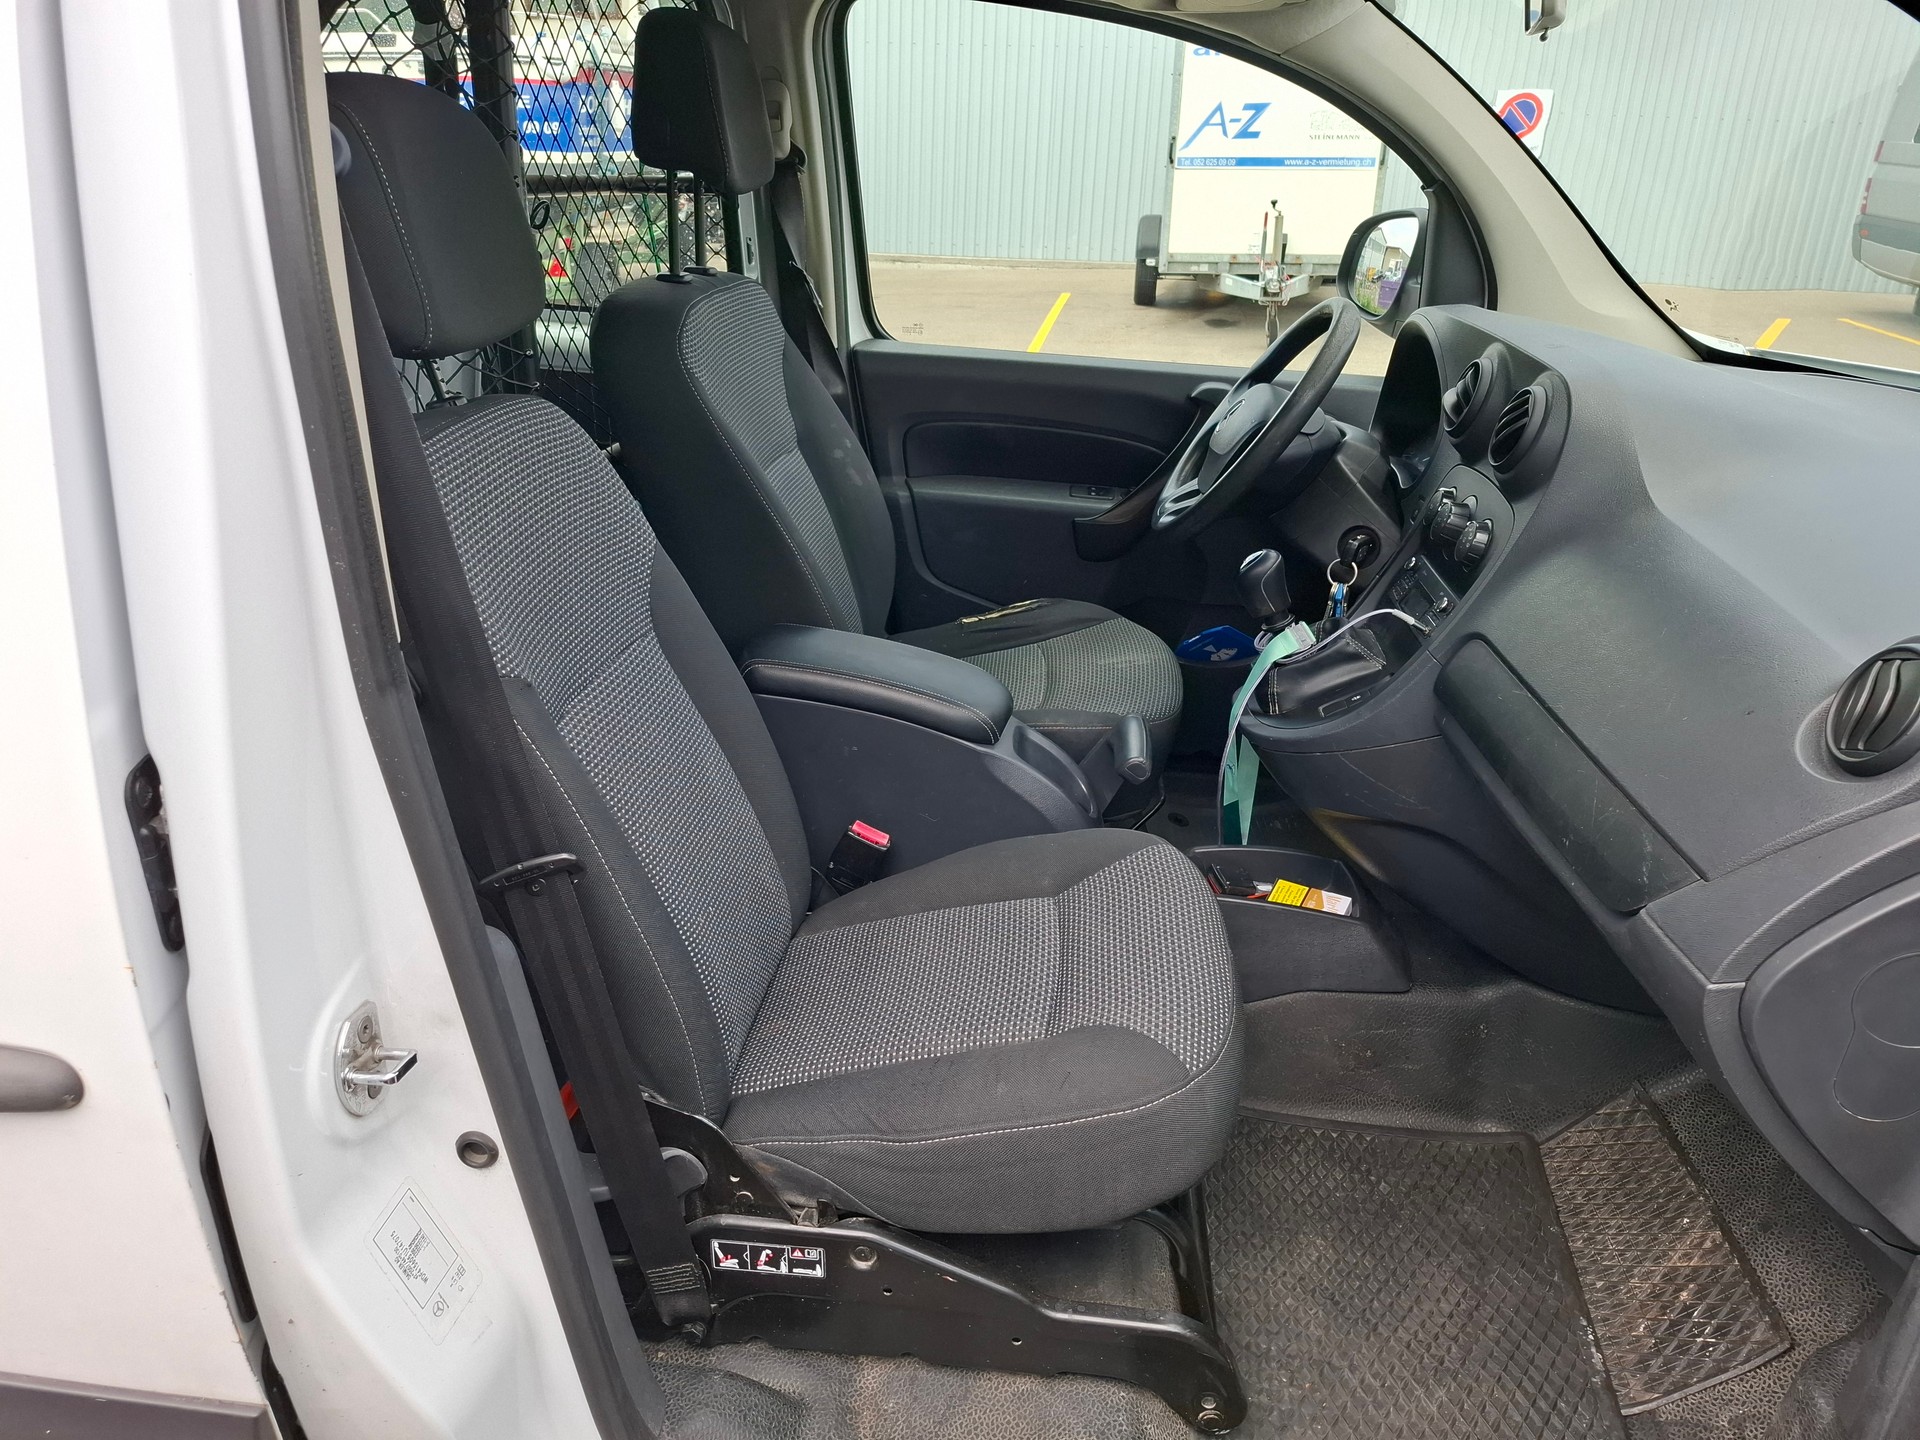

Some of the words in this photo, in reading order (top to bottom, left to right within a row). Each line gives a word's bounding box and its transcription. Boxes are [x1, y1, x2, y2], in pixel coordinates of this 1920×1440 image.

[1179, 101, 1272, 151] A-Z
[1193, 158, 1205, 166] 052
[1205, 158, 1217, 166] 625
[1218, 158, 1227, 166] 09
[1227, 158, 1236, 166] 09
[1284, 158, 1373, 167] www.a-z-vermietung.ch
